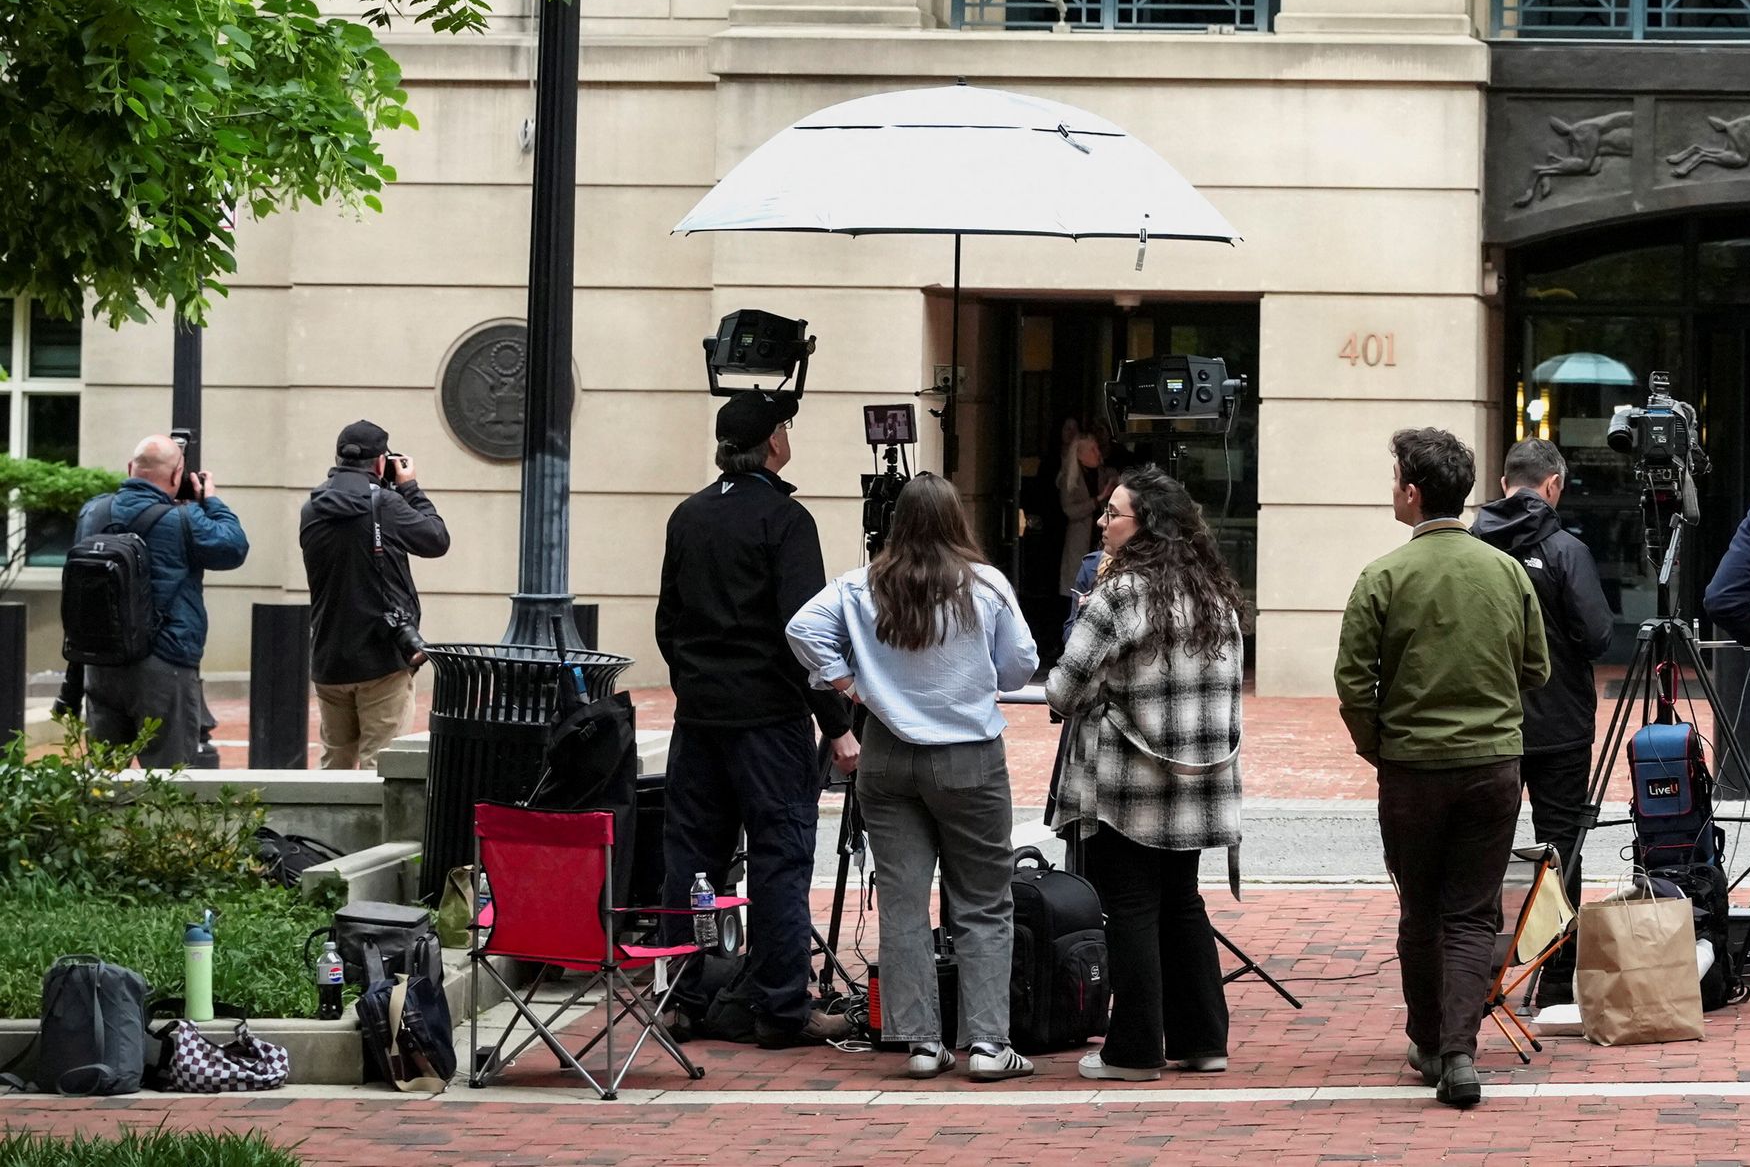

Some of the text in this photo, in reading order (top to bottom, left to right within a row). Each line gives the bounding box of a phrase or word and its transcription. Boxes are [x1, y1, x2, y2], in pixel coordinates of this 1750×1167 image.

[1338, 332, 1396, 367] 401
[374, 521, 382, 547] SONY
[1648, 782, 1679, 796] LiveU
